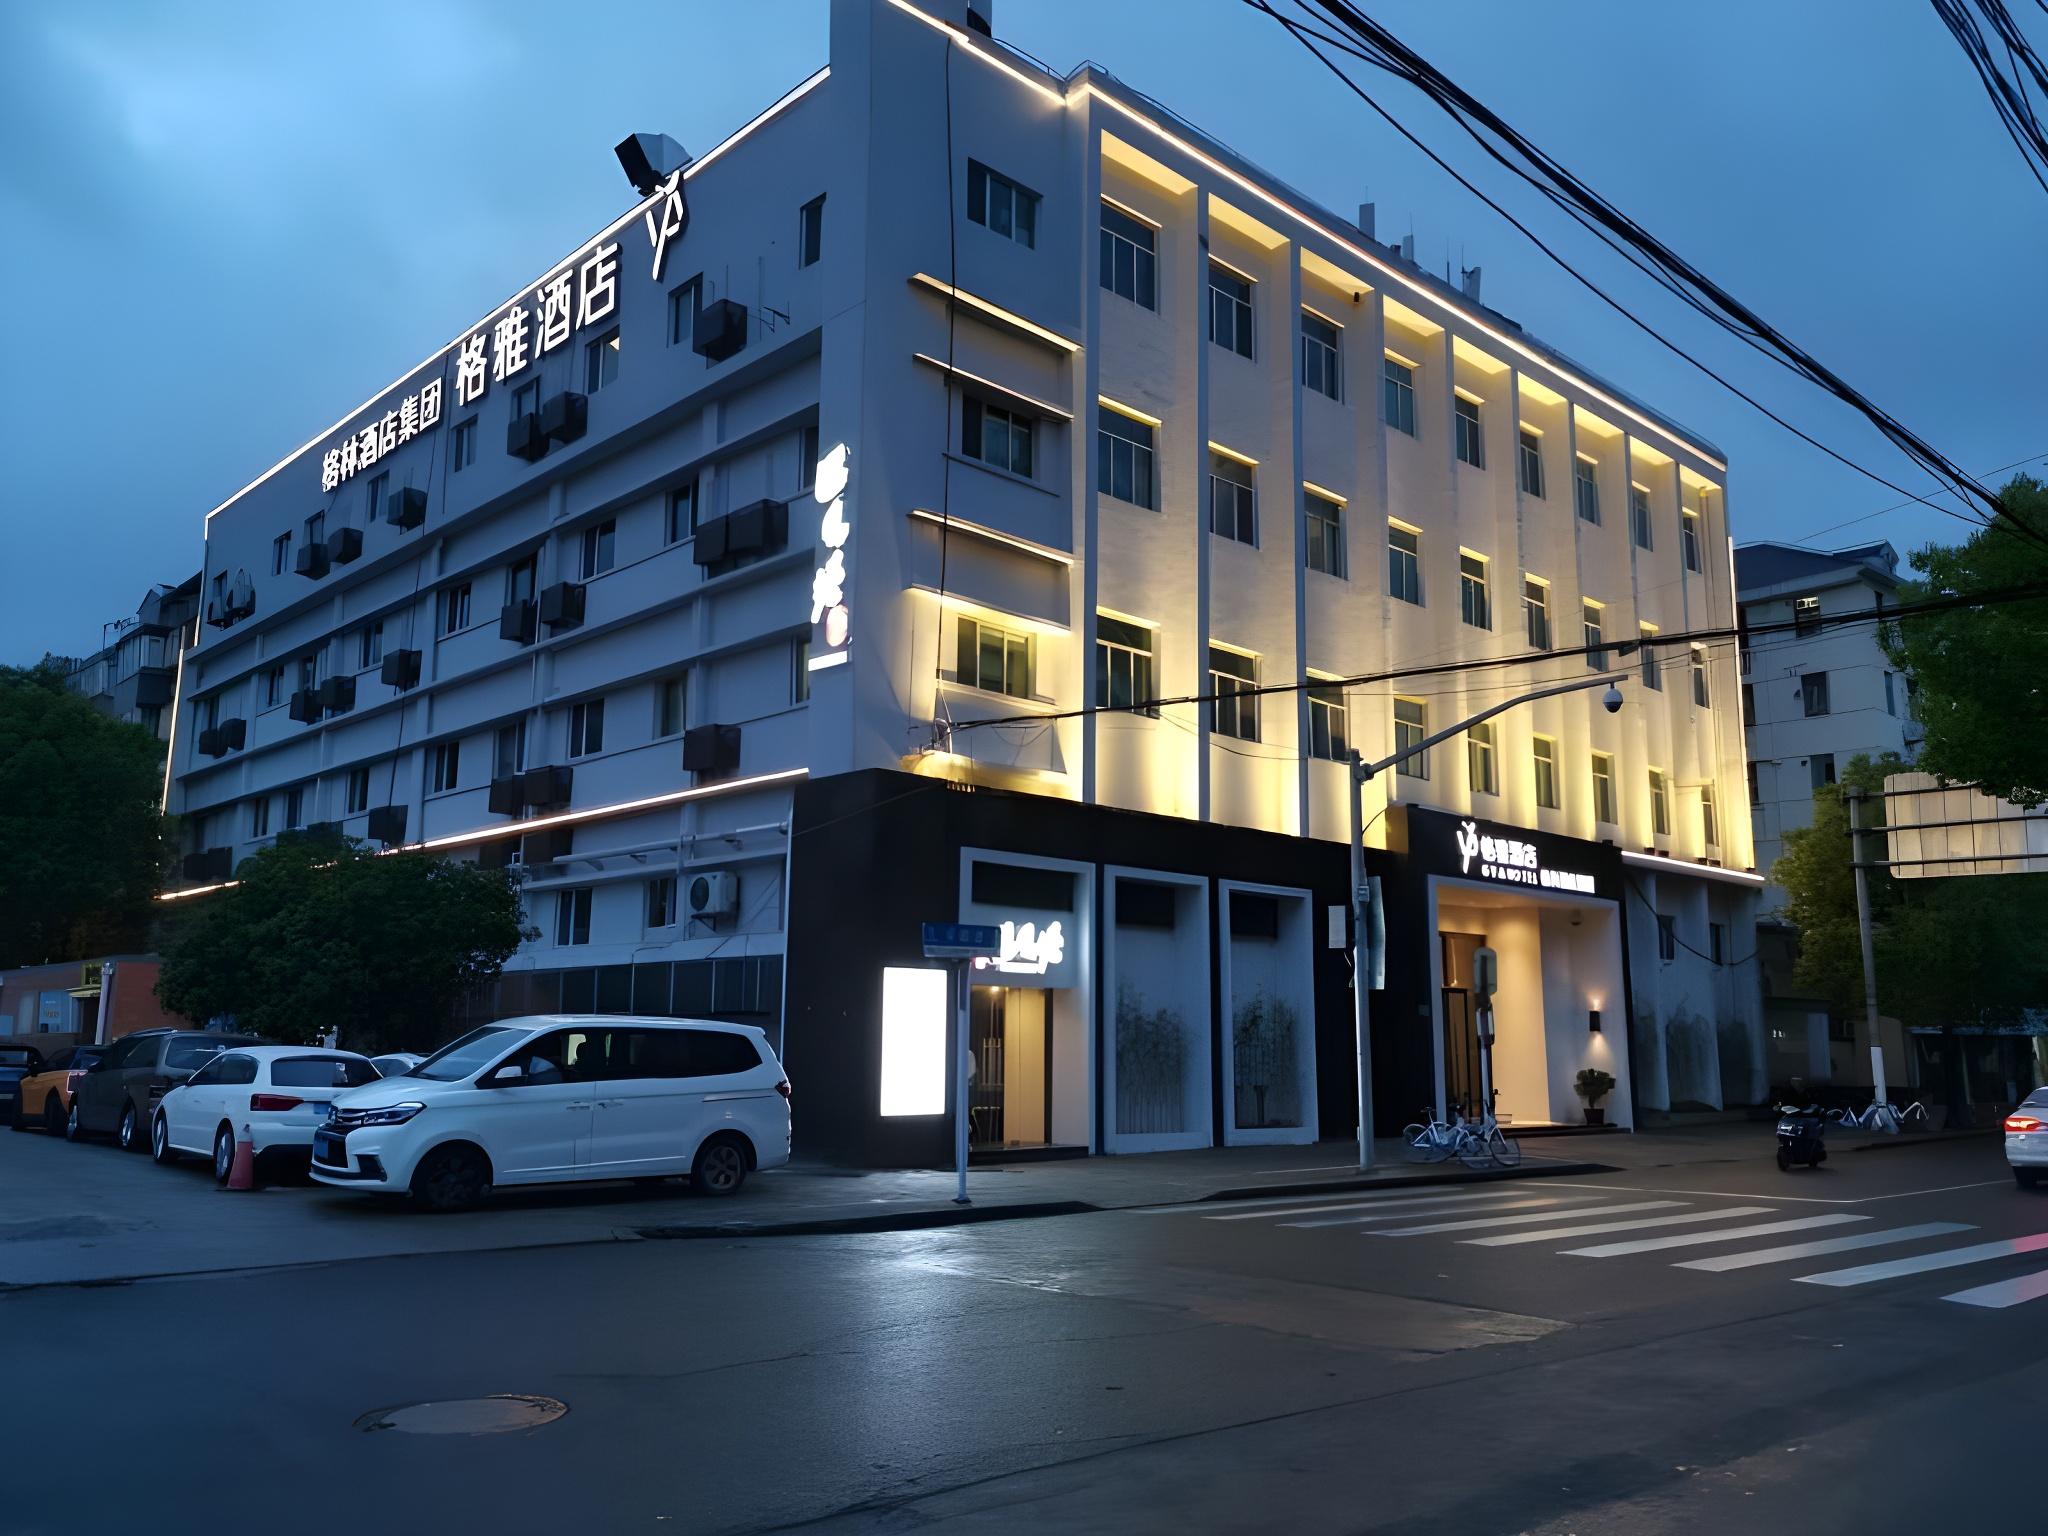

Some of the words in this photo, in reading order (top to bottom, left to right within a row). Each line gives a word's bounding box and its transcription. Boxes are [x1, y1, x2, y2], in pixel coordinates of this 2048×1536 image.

[322, 377, 442, 492] 格林酒店集团
[456, 242, 618, 406] 格雅酒店
